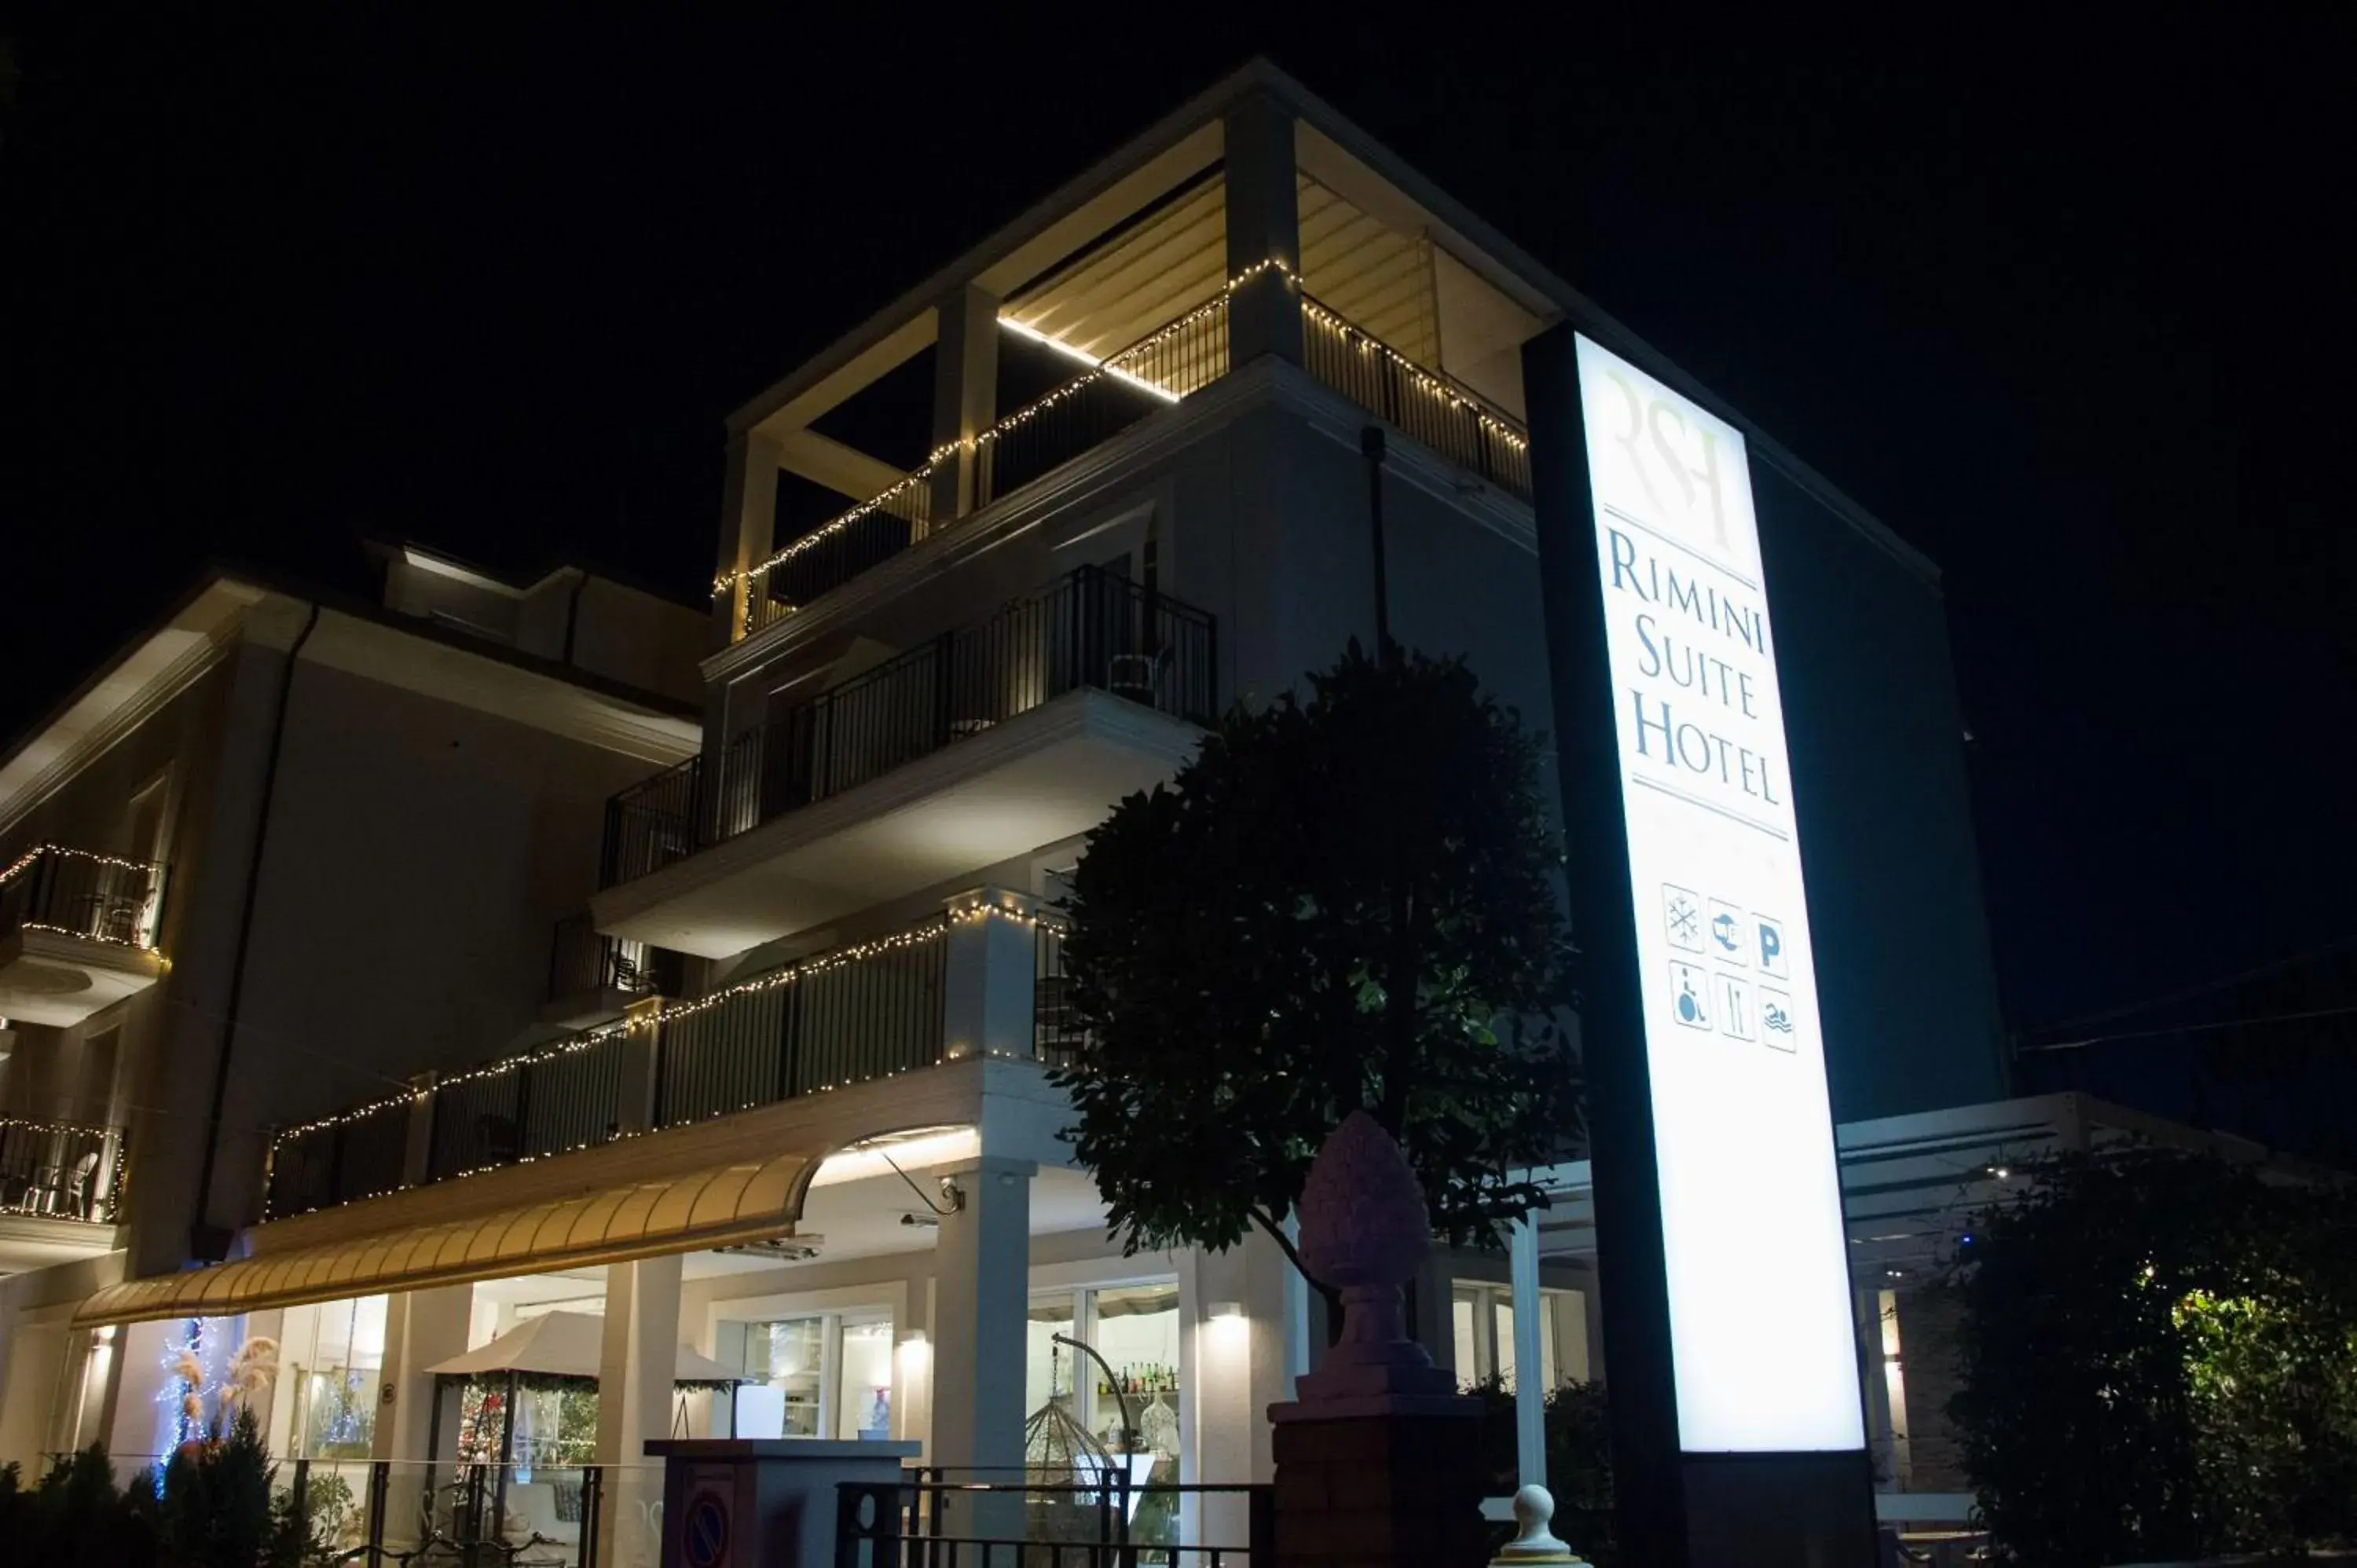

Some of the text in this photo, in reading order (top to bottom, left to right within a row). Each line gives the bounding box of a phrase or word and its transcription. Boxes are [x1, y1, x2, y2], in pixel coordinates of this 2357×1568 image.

[1606, 527, 1765, 655] RIMINI
[1636, 614, 1757, 720] SUITE
[1630, 689, 1780, 805] HOTEL
[1759, 922, 1780, 967] P
